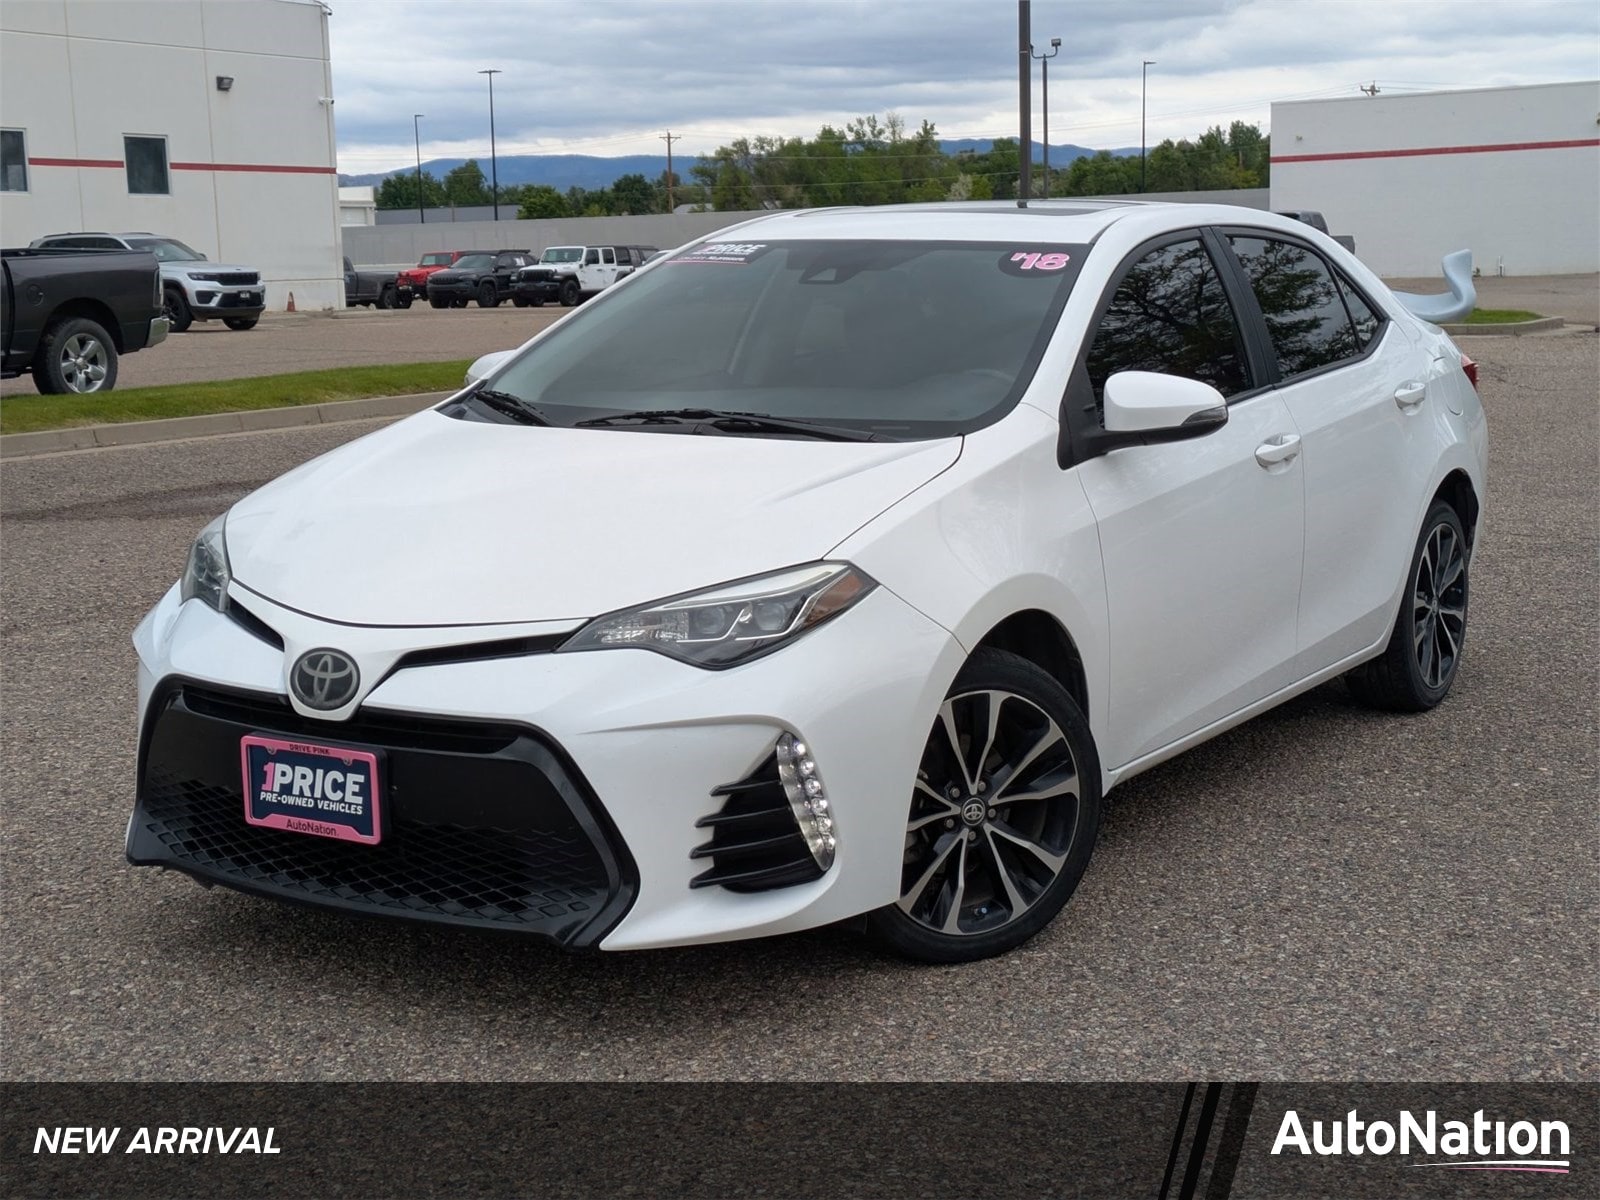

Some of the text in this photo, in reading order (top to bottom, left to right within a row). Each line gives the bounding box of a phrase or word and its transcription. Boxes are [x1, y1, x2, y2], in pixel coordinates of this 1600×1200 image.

[1010, 252, 1070, 270] '18
[289, 744, 330, 755] DRIVE PINK
[261, 762, 365, 804] 1PRICE
[260, 791, 363, 814] PRE-OWNED VEHICLES
[286, 819, 337, 837] AutoNation
